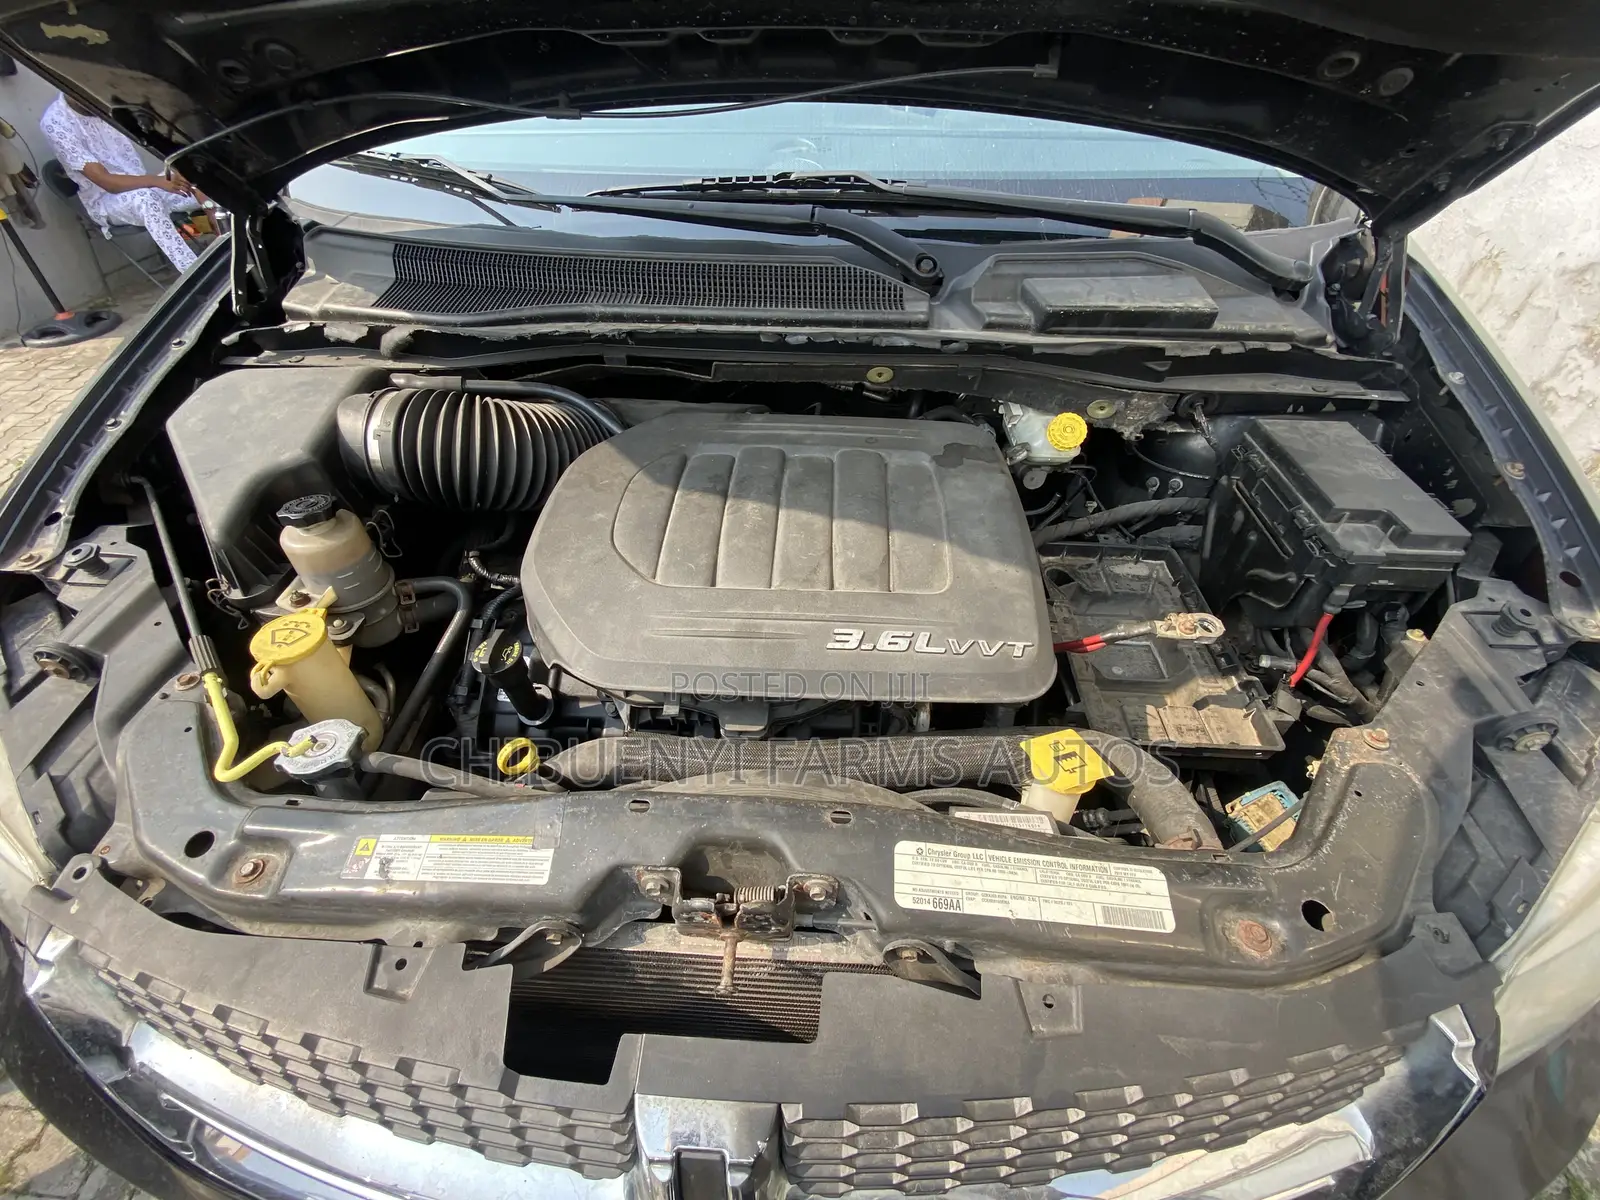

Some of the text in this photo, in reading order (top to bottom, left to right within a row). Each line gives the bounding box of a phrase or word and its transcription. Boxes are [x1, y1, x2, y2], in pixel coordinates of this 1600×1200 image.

[927, 848, 952, 857] Chrysler
[953, 850, 970, 860] Group
[972, 852, 984, 860] LLC
[988, 854, 1012, 863] VEHICLE
[1013, 857, 1041, 867] EMISSION
[1042, 860, 1069, 869] CONTROL
[1069, 863, 1109, 874] INFORMATION
[912, 897, 962, 911] 52014 669AA
